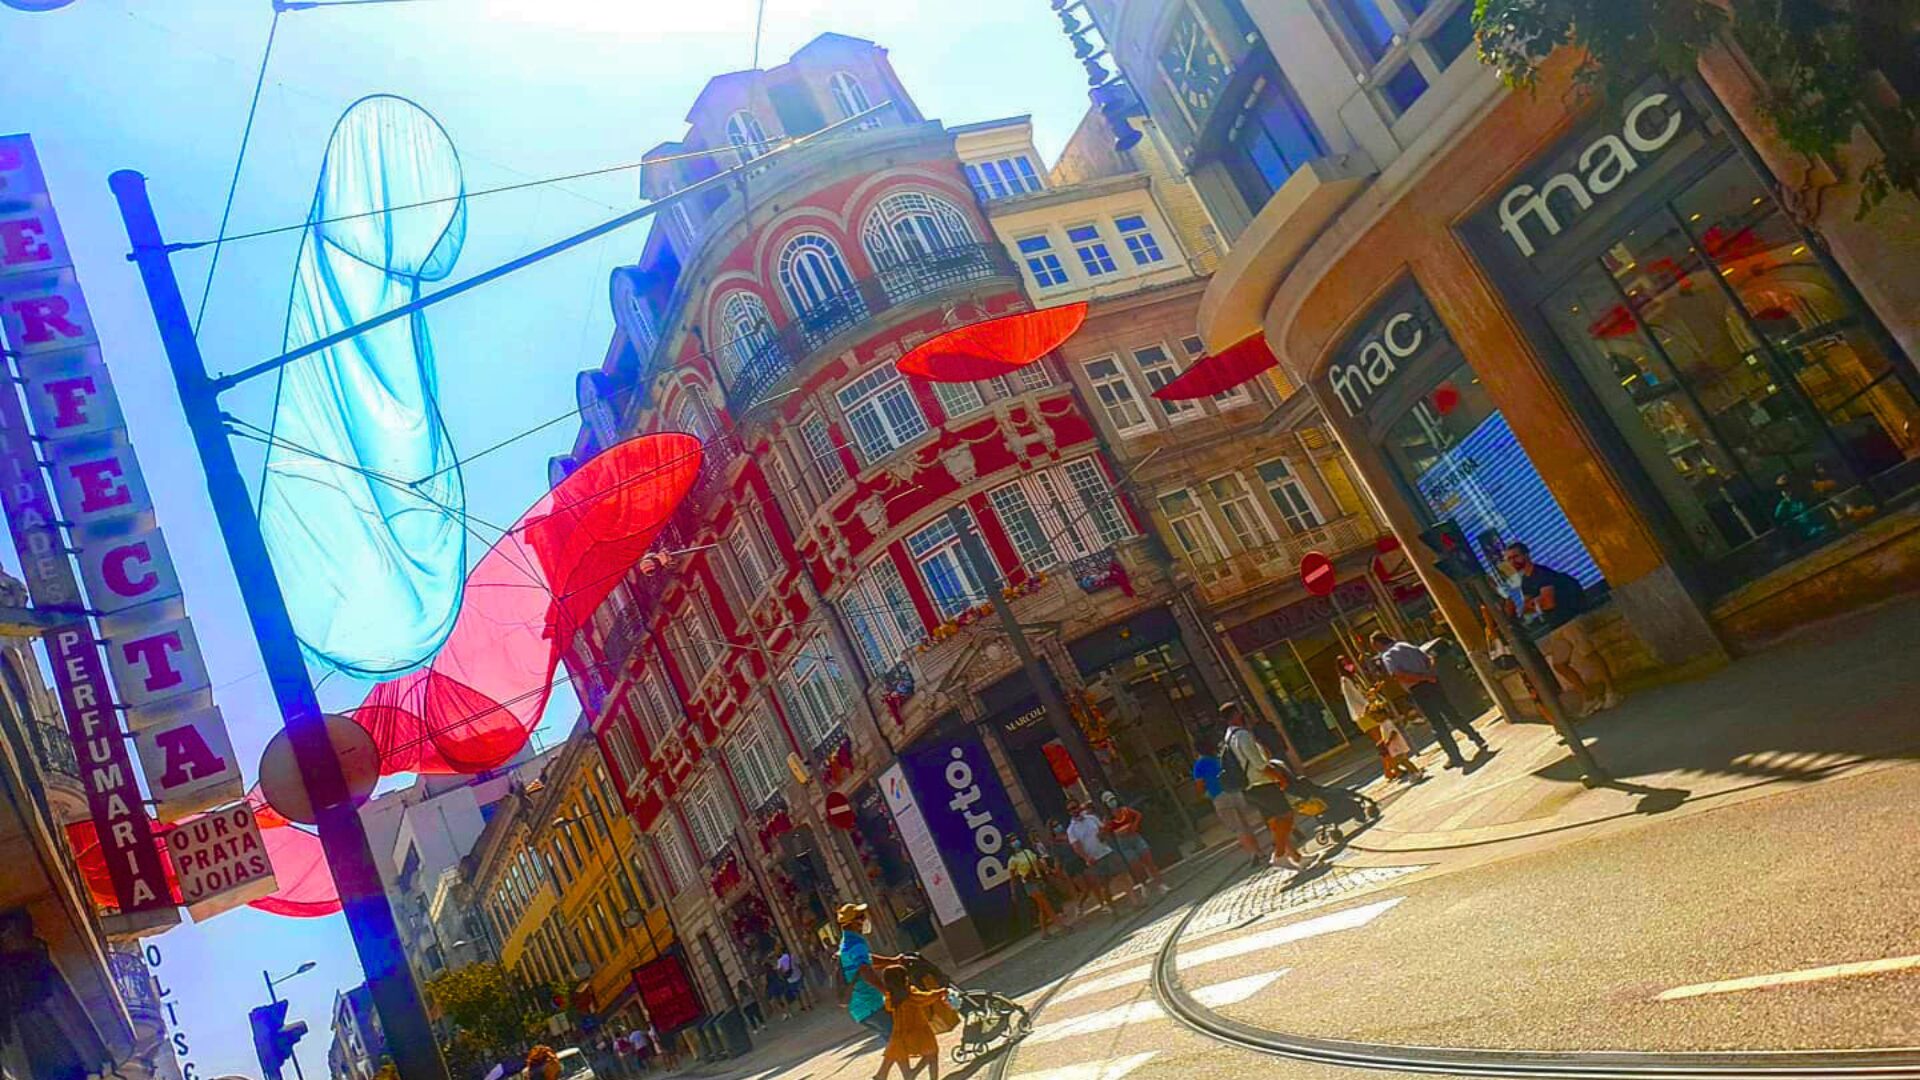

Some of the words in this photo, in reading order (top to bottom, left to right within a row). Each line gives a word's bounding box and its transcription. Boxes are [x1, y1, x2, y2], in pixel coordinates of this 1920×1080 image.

[1498, 93, 1682, 257] fnac
[1328, 312, 1422, 417] fnac
[58, 630, 155, 907] PERFUMARIA
[945, 747, 1011, 891] Porto.
[173, 809, 249, 850] OURO
[178, 831, 258, 875] PRATA
[190, 855, 266, 897] JOIAS
